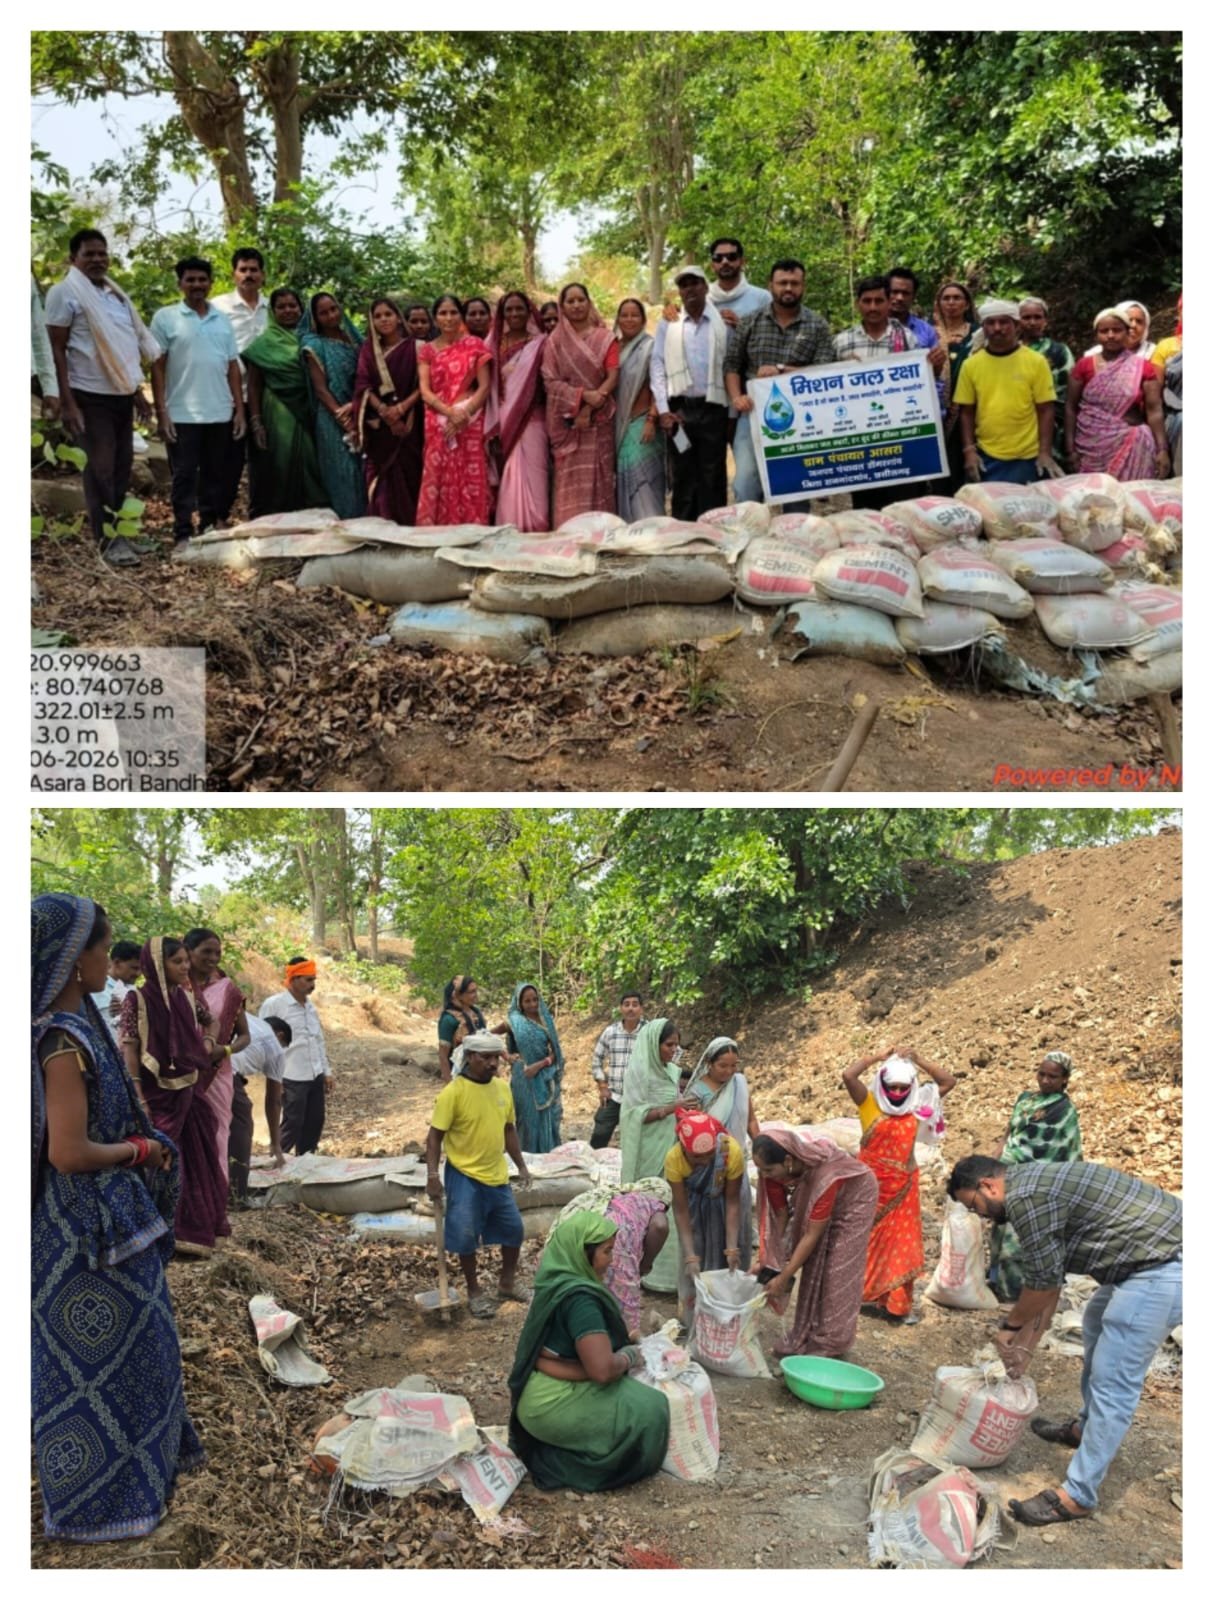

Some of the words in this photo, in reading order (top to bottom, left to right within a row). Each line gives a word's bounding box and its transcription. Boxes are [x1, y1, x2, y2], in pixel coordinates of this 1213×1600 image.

[790, 374, 844, 396] मिशन
[848, 368, 884, 386] जल
[888, 363, 921, 381] रक्षा
[803, 456, 825, 468] ग्राम
[828, 450, 864, 464] पंचायत
[869, 445, 903, 458] आसरा
[836, 462, 864, 474] पंचायत
[801, 477, 822, 489] जिला
[844, 557, 911, 579] CEMENT
